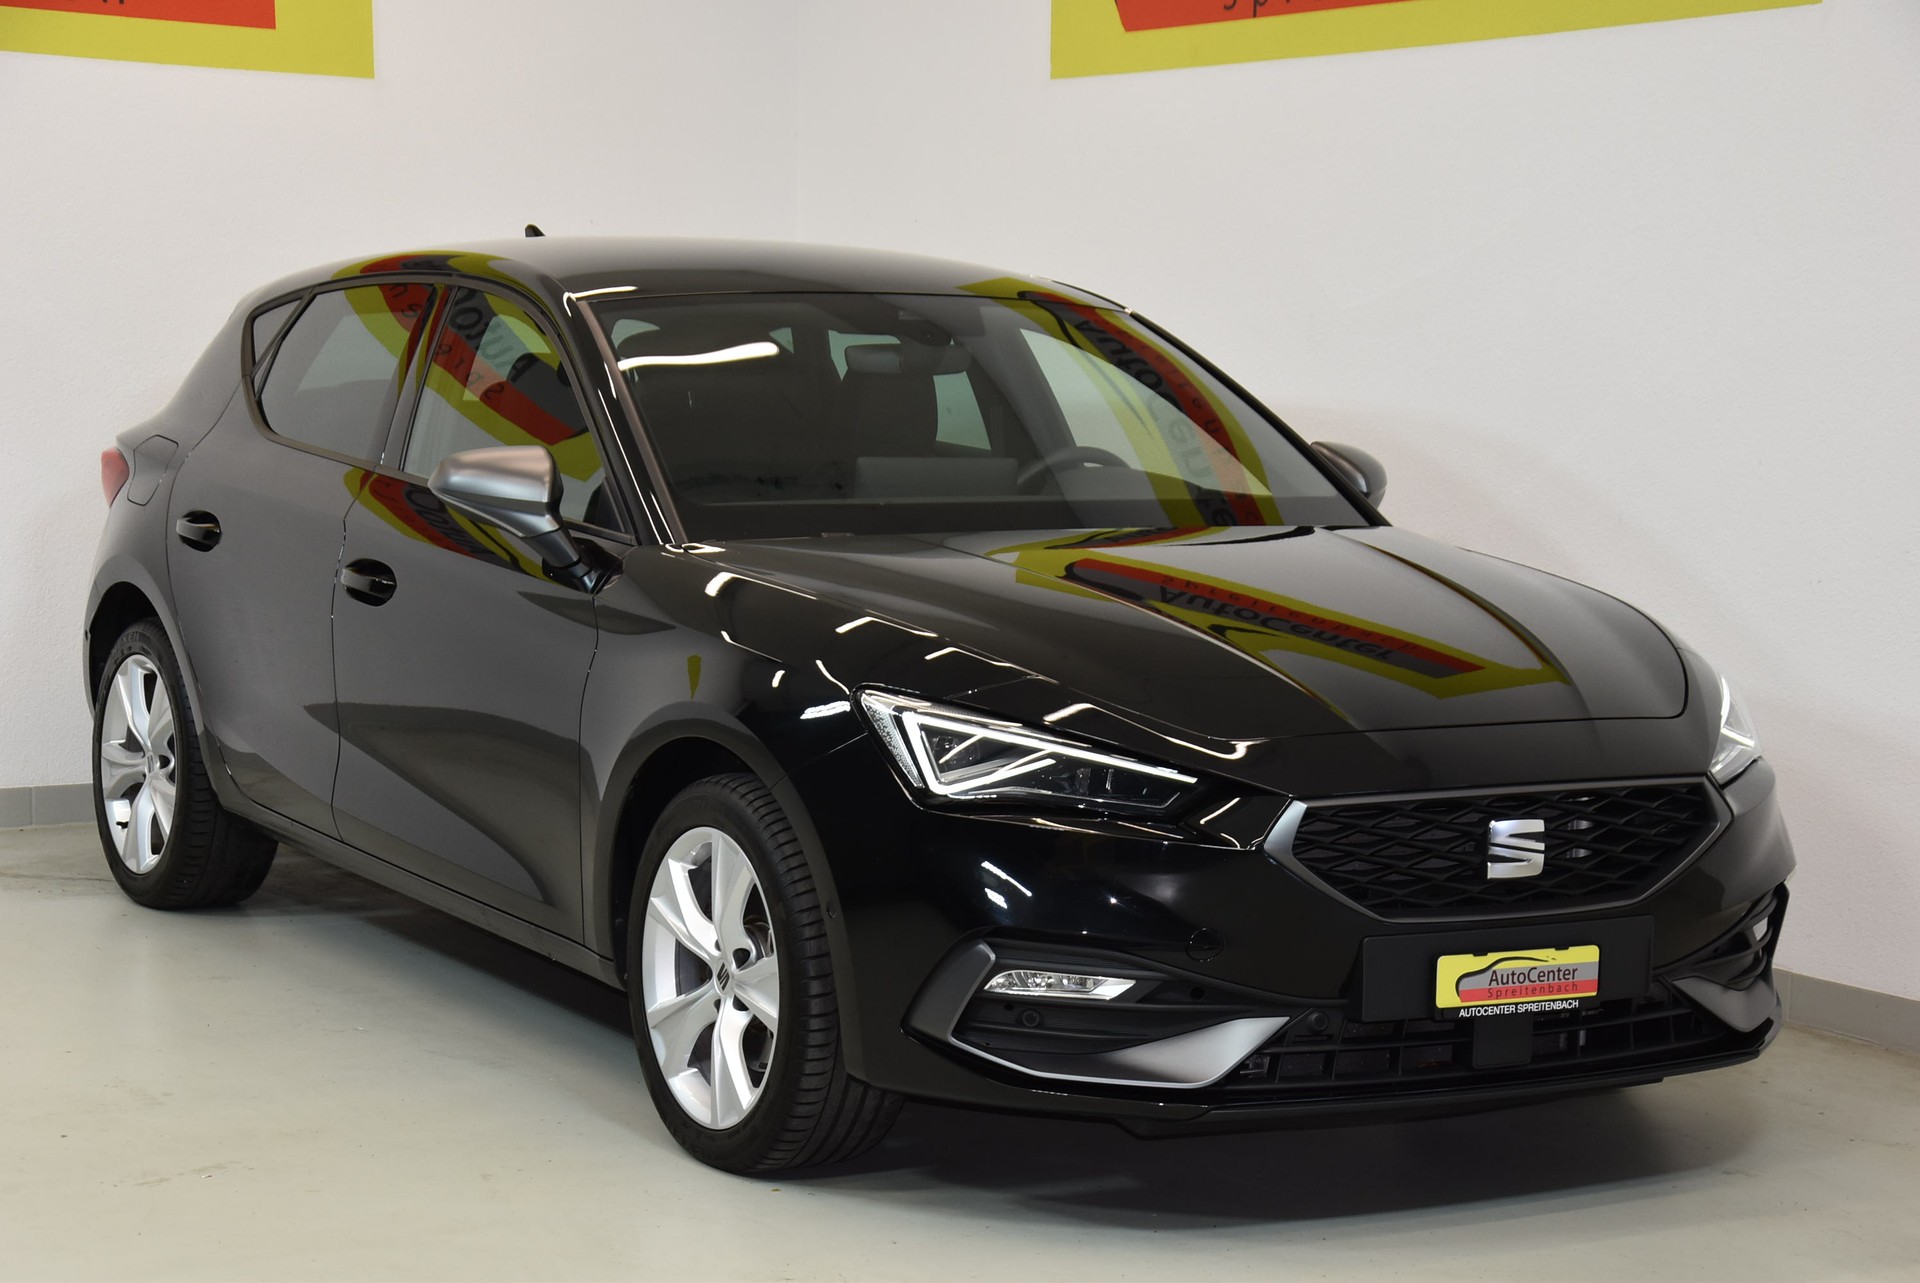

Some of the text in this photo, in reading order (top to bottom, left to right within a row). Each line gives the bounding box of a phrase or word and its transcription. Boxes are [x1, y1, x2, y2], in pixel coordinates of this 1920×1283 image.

[1488, 966, 1578, 986] AutoCenter
[1488, 981, 1578, 999] Spreitenbach
[1458, 999, 1579, 1017] AUTOCENTER SPREITENBACH
